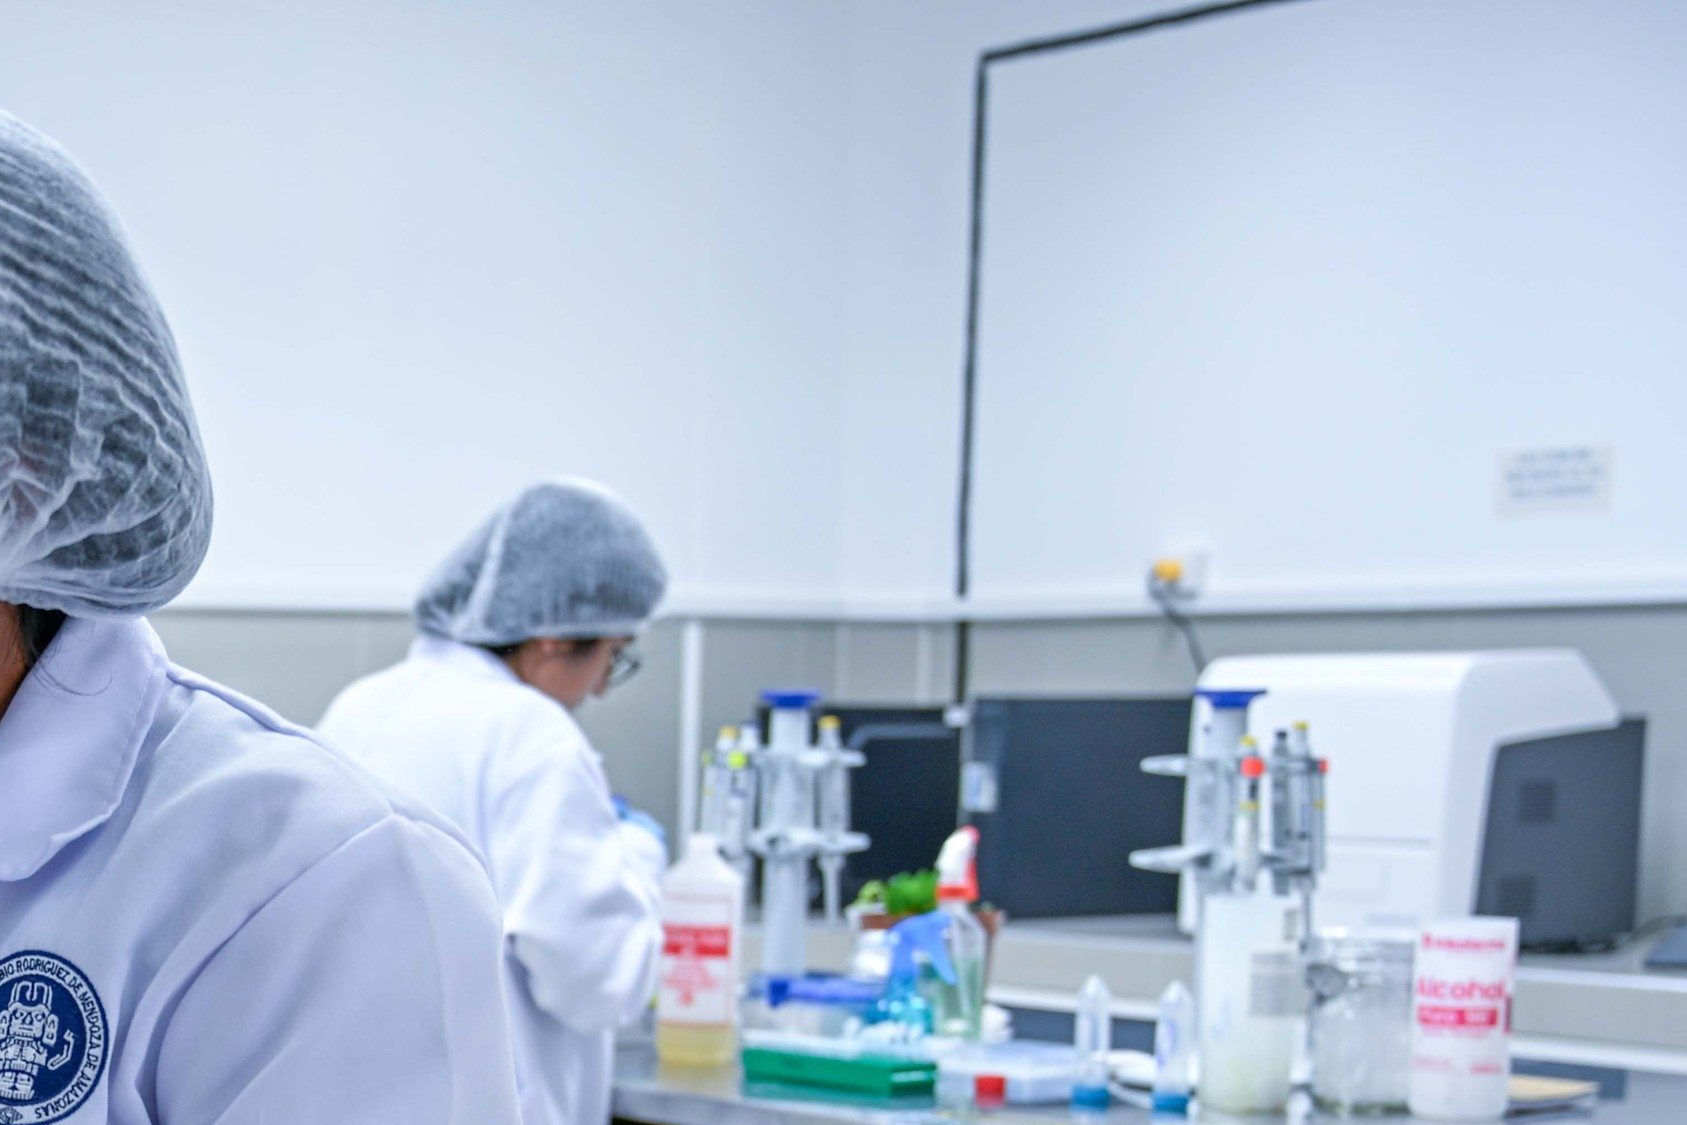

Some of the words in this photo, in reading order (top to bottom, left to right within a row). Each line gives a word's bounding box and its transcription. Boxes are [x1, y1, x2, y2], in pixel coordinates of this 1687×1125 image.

[16, 958, 70, 982] RODRIGUEZ
[68, 977, 84, 994] DE
[79, 991, 102, 1048] MENDOZA
[85, 1051, 99, 1070] DE
[34, 1070, 91, 1119] AMAZONAS
